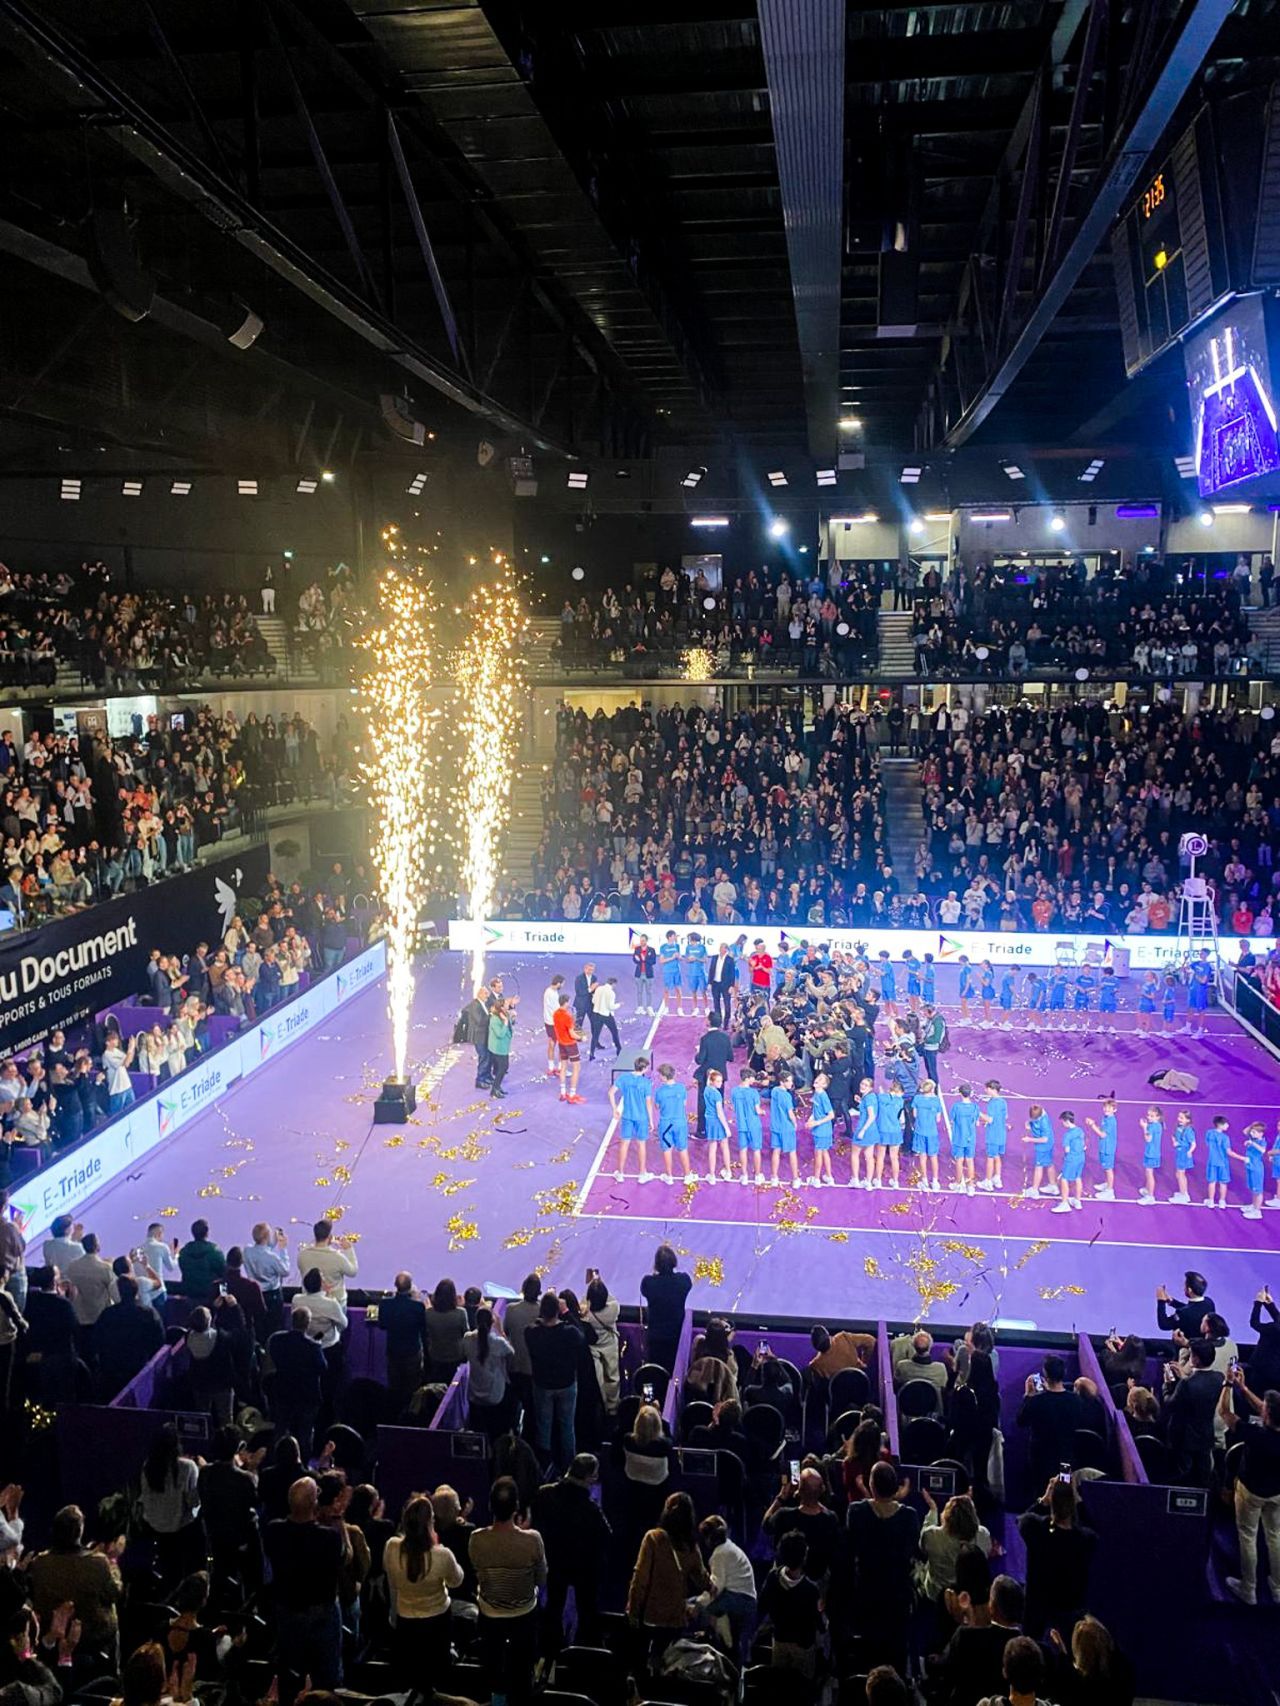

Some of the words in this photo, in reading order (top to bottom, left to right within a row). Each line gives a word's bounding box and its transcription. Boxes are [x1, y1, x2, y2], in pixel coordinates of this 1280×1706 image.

[0, 971, 18, 1003] u
[20, 916, 138, 994] Document
[38, 995, 46, 1010] &
[48, 983, 72, 1005] TOUS
[73, 965, 112, 993] FORMATS
[181, 1071, 221, 1110] E-Triade
[43, 1157, 102, 1211] E-Triade
